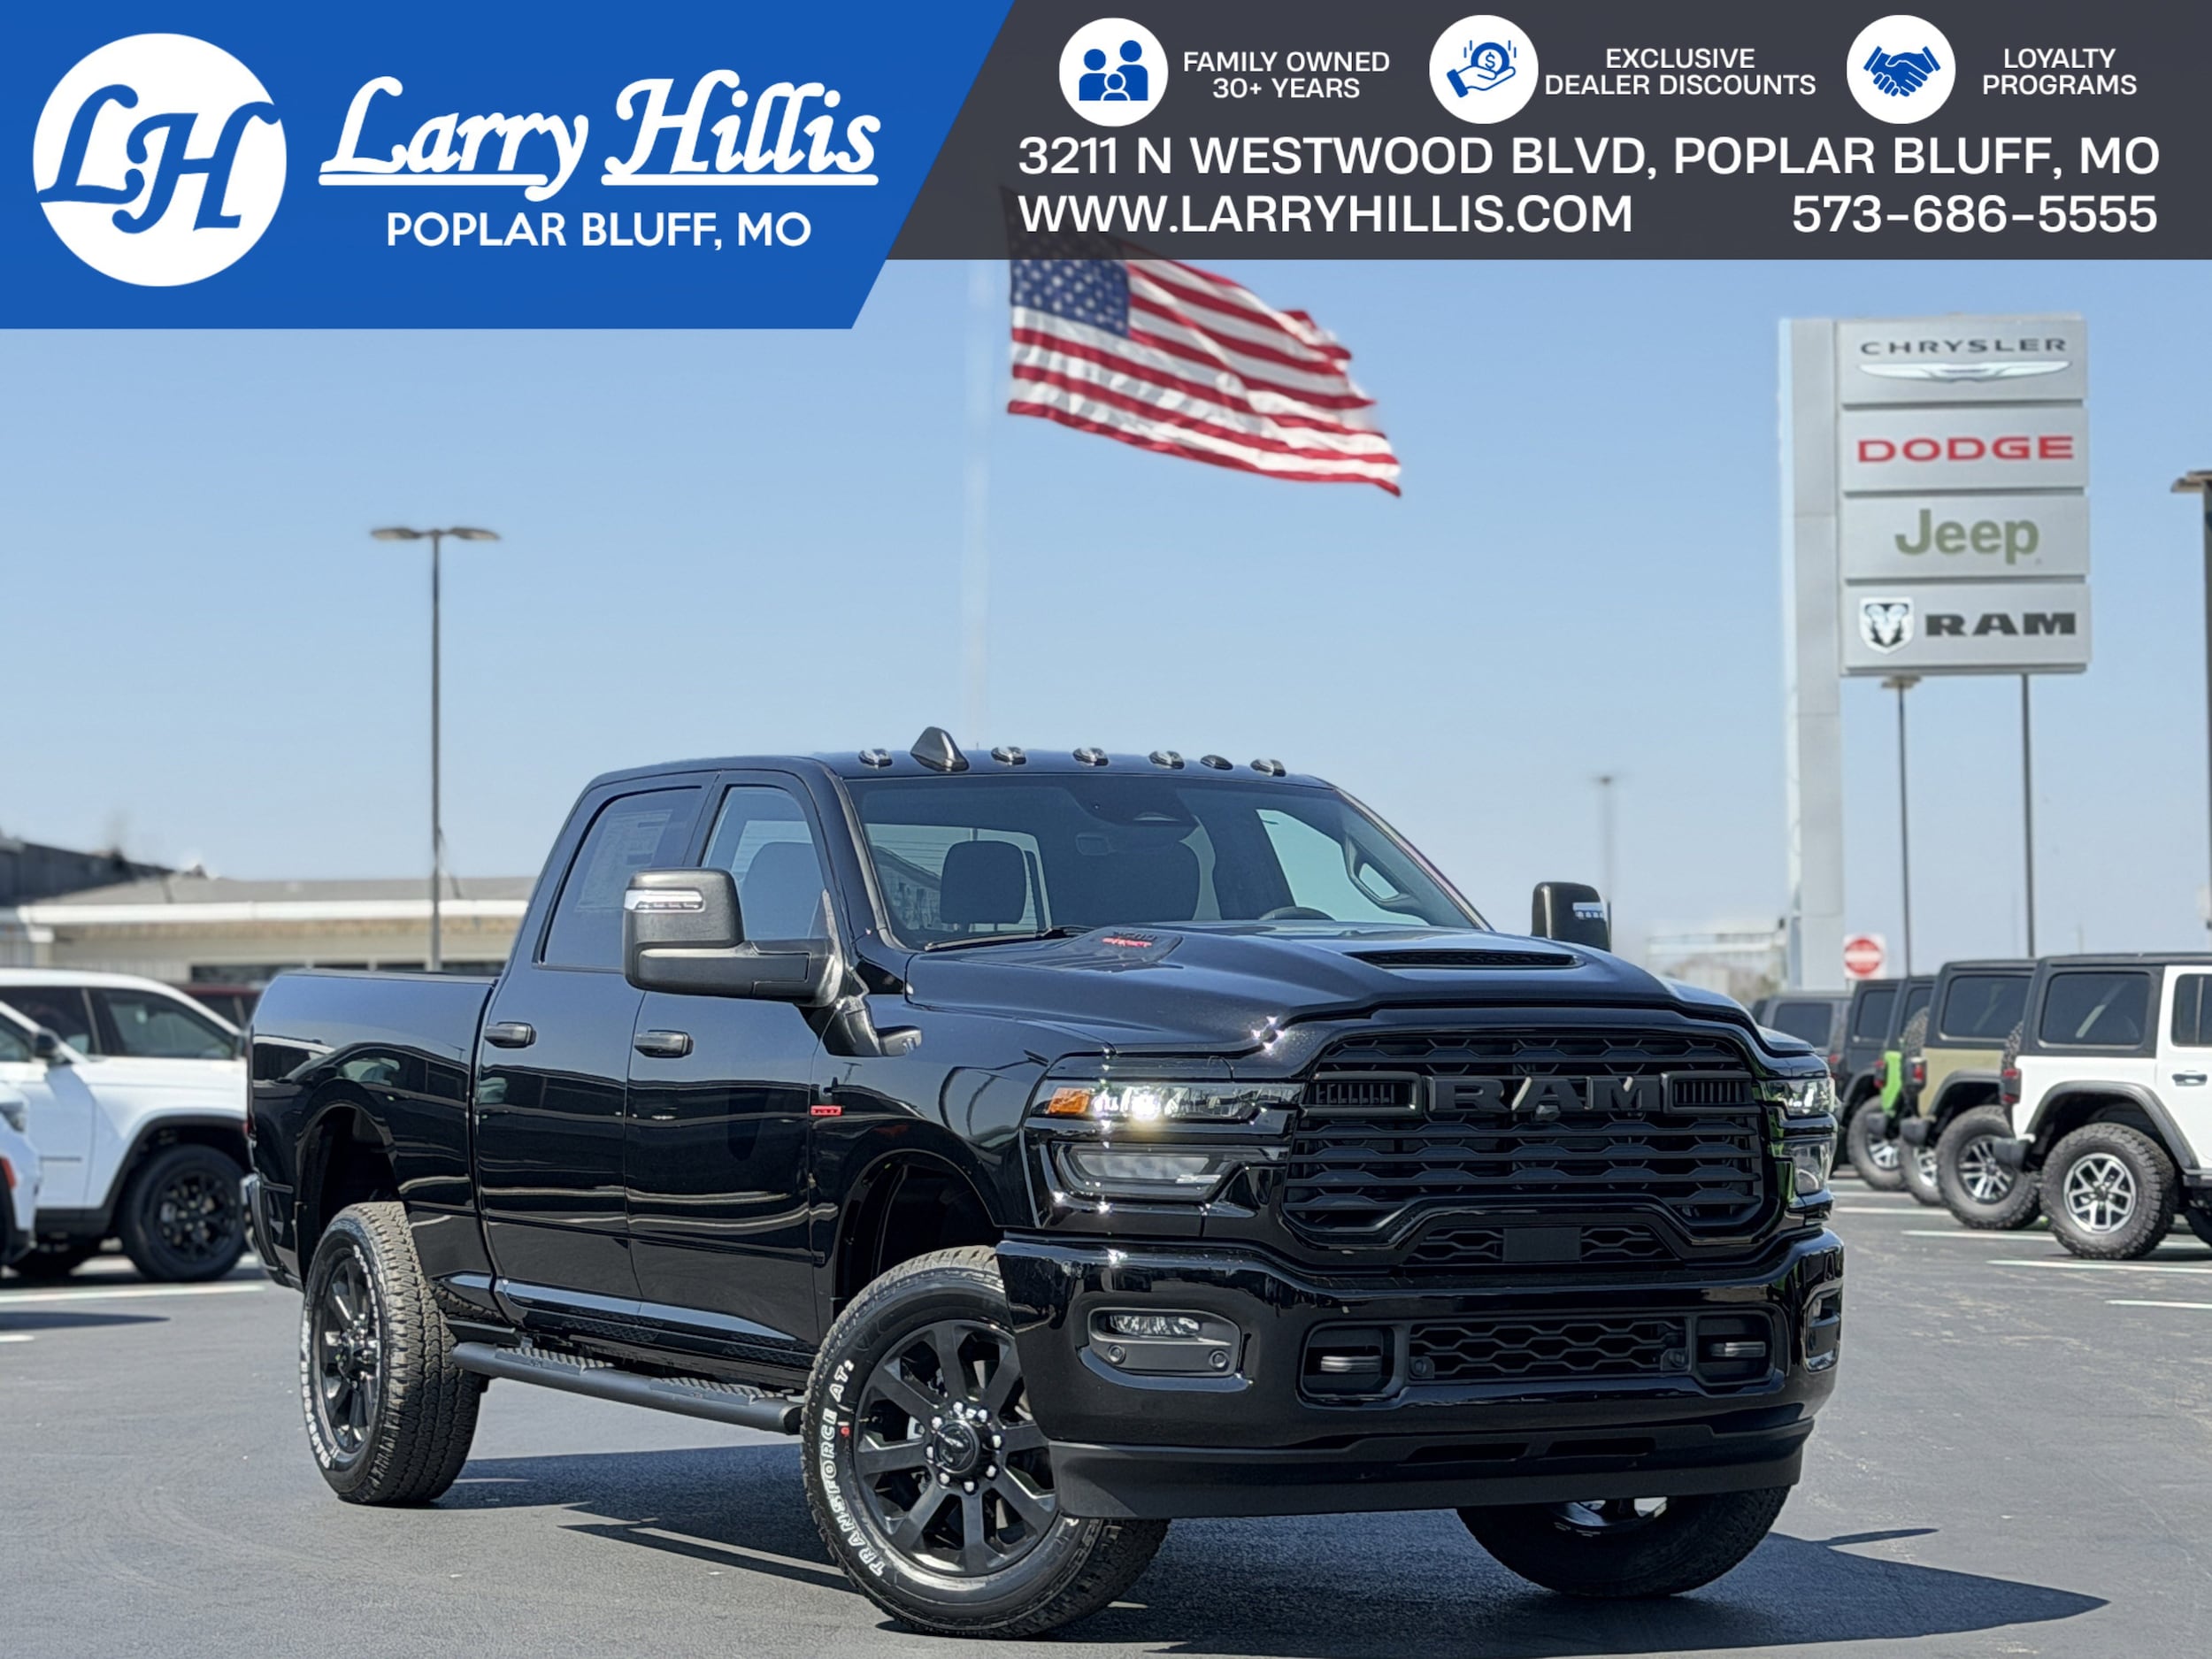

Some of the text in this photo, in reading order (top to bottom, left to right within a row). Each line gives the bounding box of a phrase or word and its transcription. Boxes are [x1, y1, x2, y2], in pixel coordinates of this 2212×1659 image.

[1860, 338, 2067, 356] CHRYSLER
[1858, 435, 2074, 463] DODGE
[1895, 508, 2040, 565] Jeep
[1925, 612, 2077, 636] RAM
[1425, 1075, 1662, 1113] RAM
